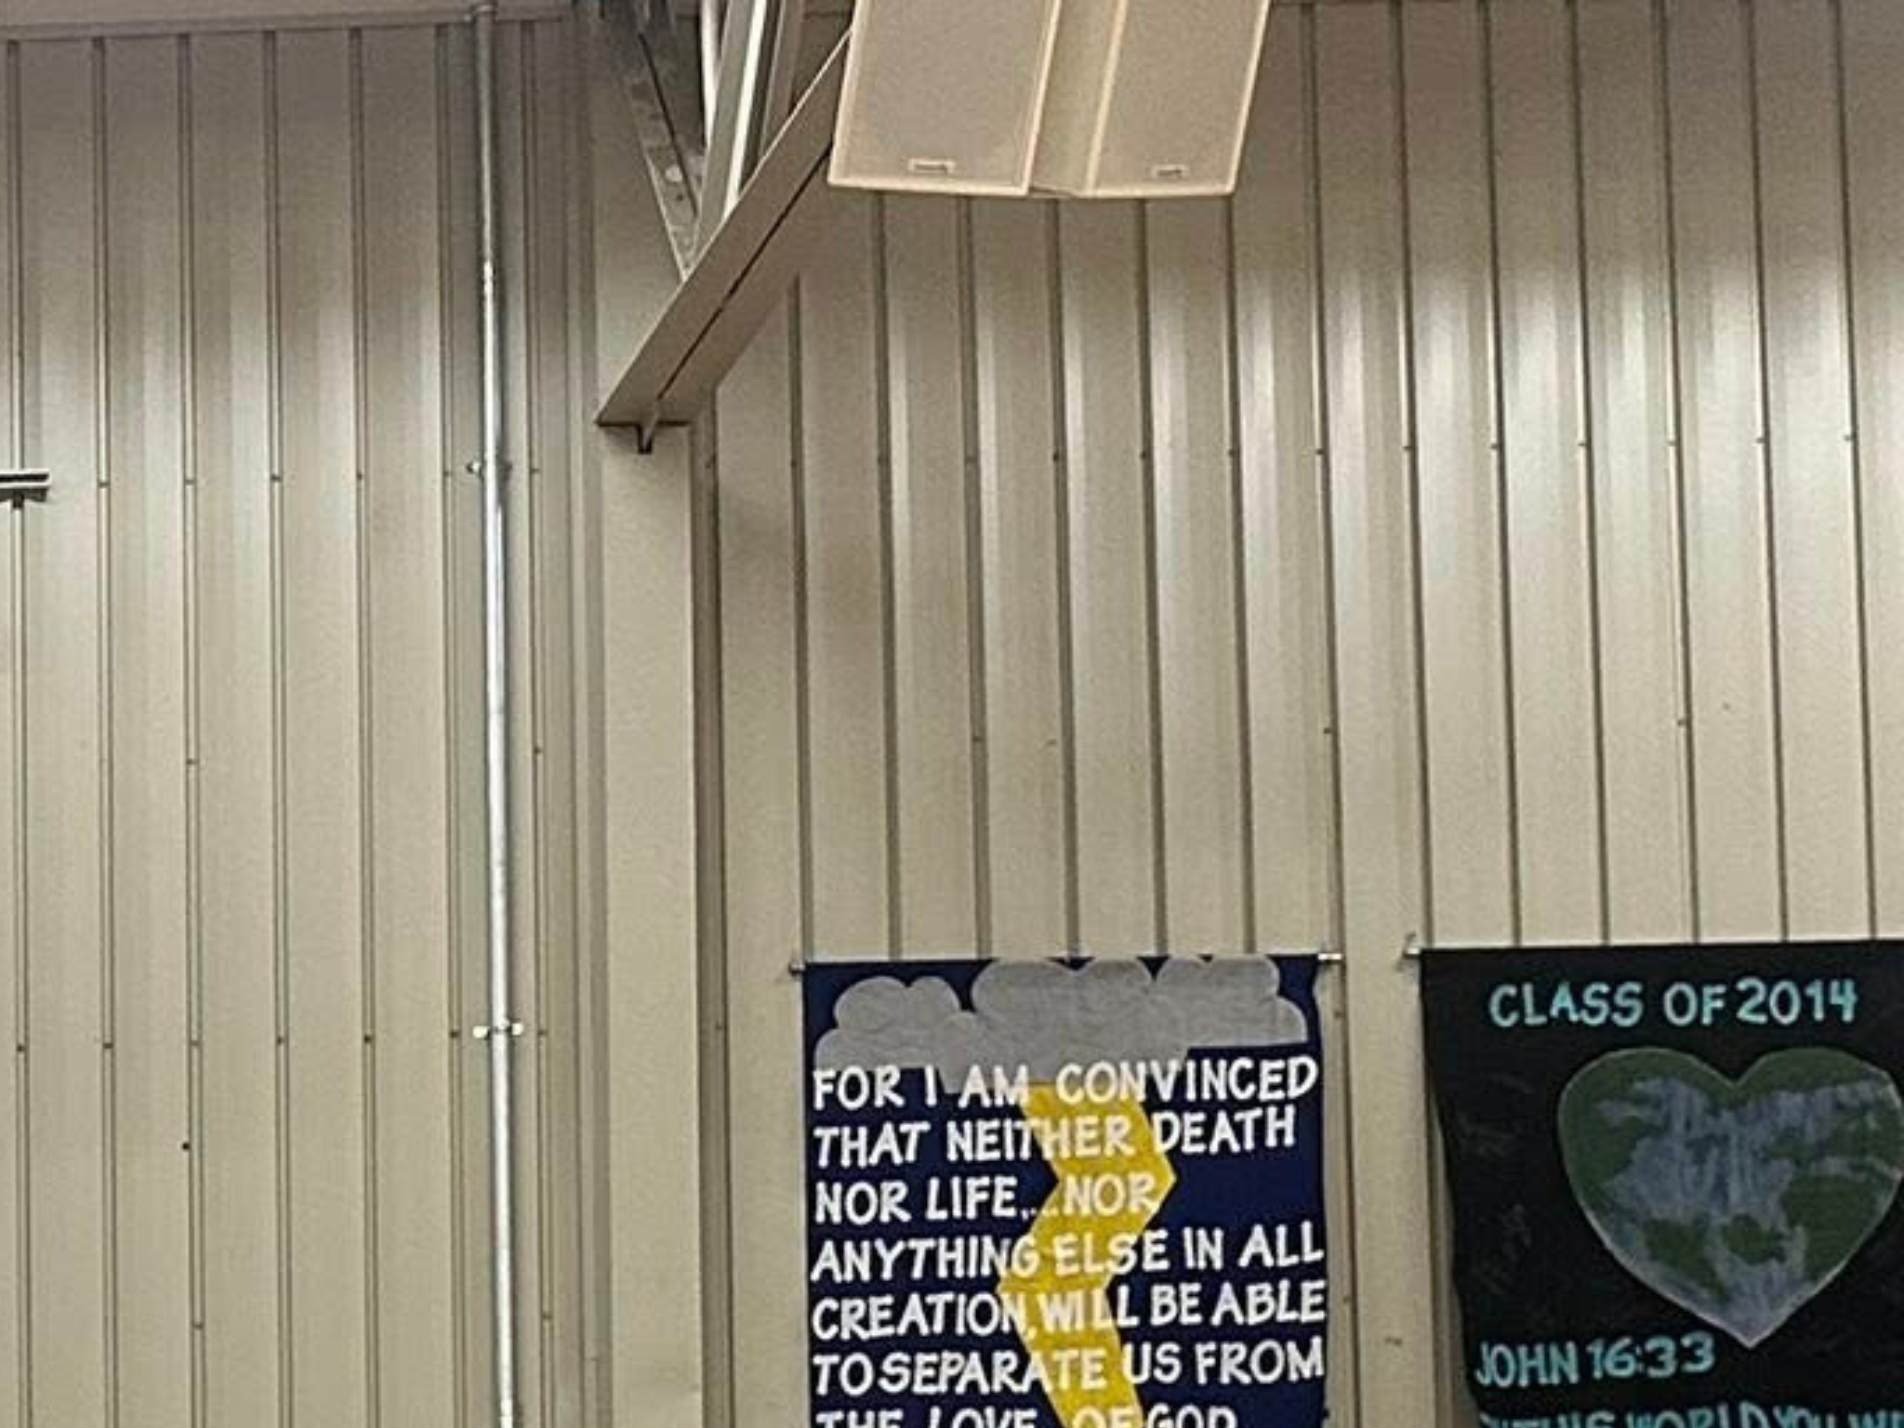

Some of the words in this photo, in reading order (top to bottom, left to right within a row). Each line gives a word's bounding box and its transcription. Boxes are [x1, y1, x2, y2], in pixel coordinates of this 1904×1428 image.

[1491, 981, 1643, 1027] CLASS
[1664, 982, 1725, 1026] OF
[1736, 977, 1858, 1025] 2014
[814, 1066, 904, 1110] FOR
[925, 1068, 936, 1106] I
[959, 1064, 1030, 1107] AM
[1056, 1055, 1319, 1103] CONVINCED
[815, 1121, 930, 1166] THAT
[947, 1116, 1132, 1161] NEITHER
[1154, 1106, 1296, 1152] DEATH
[816, 1180, 913, 1224] NOR
[811, 1236, 1039, 1283] ANYTHING
[1054, 1232, 1169, 1276] ELSE
[1184, 1227, 1224, 1269] IN
[1239, 1222, 1325, 1273] ALL
[812, 1290, 1037, 1340] CREATION,
[1045, 1285, 1138, 1332] WILL
[1151, 1284, 1199, 1327] BE
[1210, 1279, 1327, 1324] ABLE
[814, 1349, 877, 1397] TO
[879, 1346, 1108, 1394] SEPARATE
[1124, 1341, 1181, 1386] US
[1196, 1337, 1324, 1384] FROM
[1475, 1342, 1578, 1388] JOHN
[1592, 1333, 1714, 1377] 16:33
